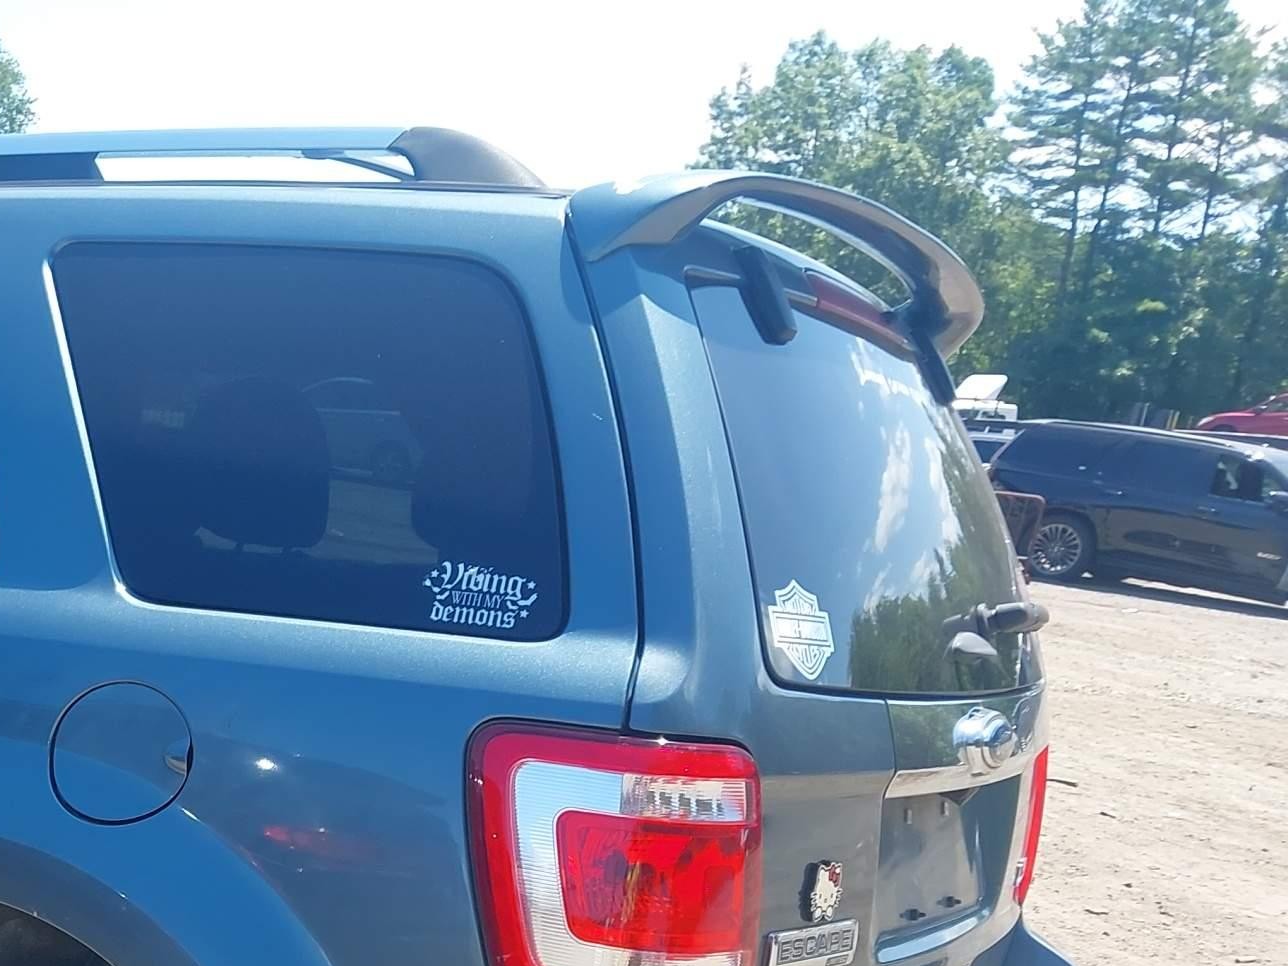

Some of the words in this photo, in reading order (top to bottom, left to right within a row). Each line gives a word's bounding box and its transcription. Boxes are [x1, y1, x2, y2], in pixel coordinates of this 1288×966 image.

[452, 590, 484, 607] WITH
[483, 594, 505, 609] MY
[430, 600, 519, 629] demons
[779, 929, 852, 961] ESCAPE
